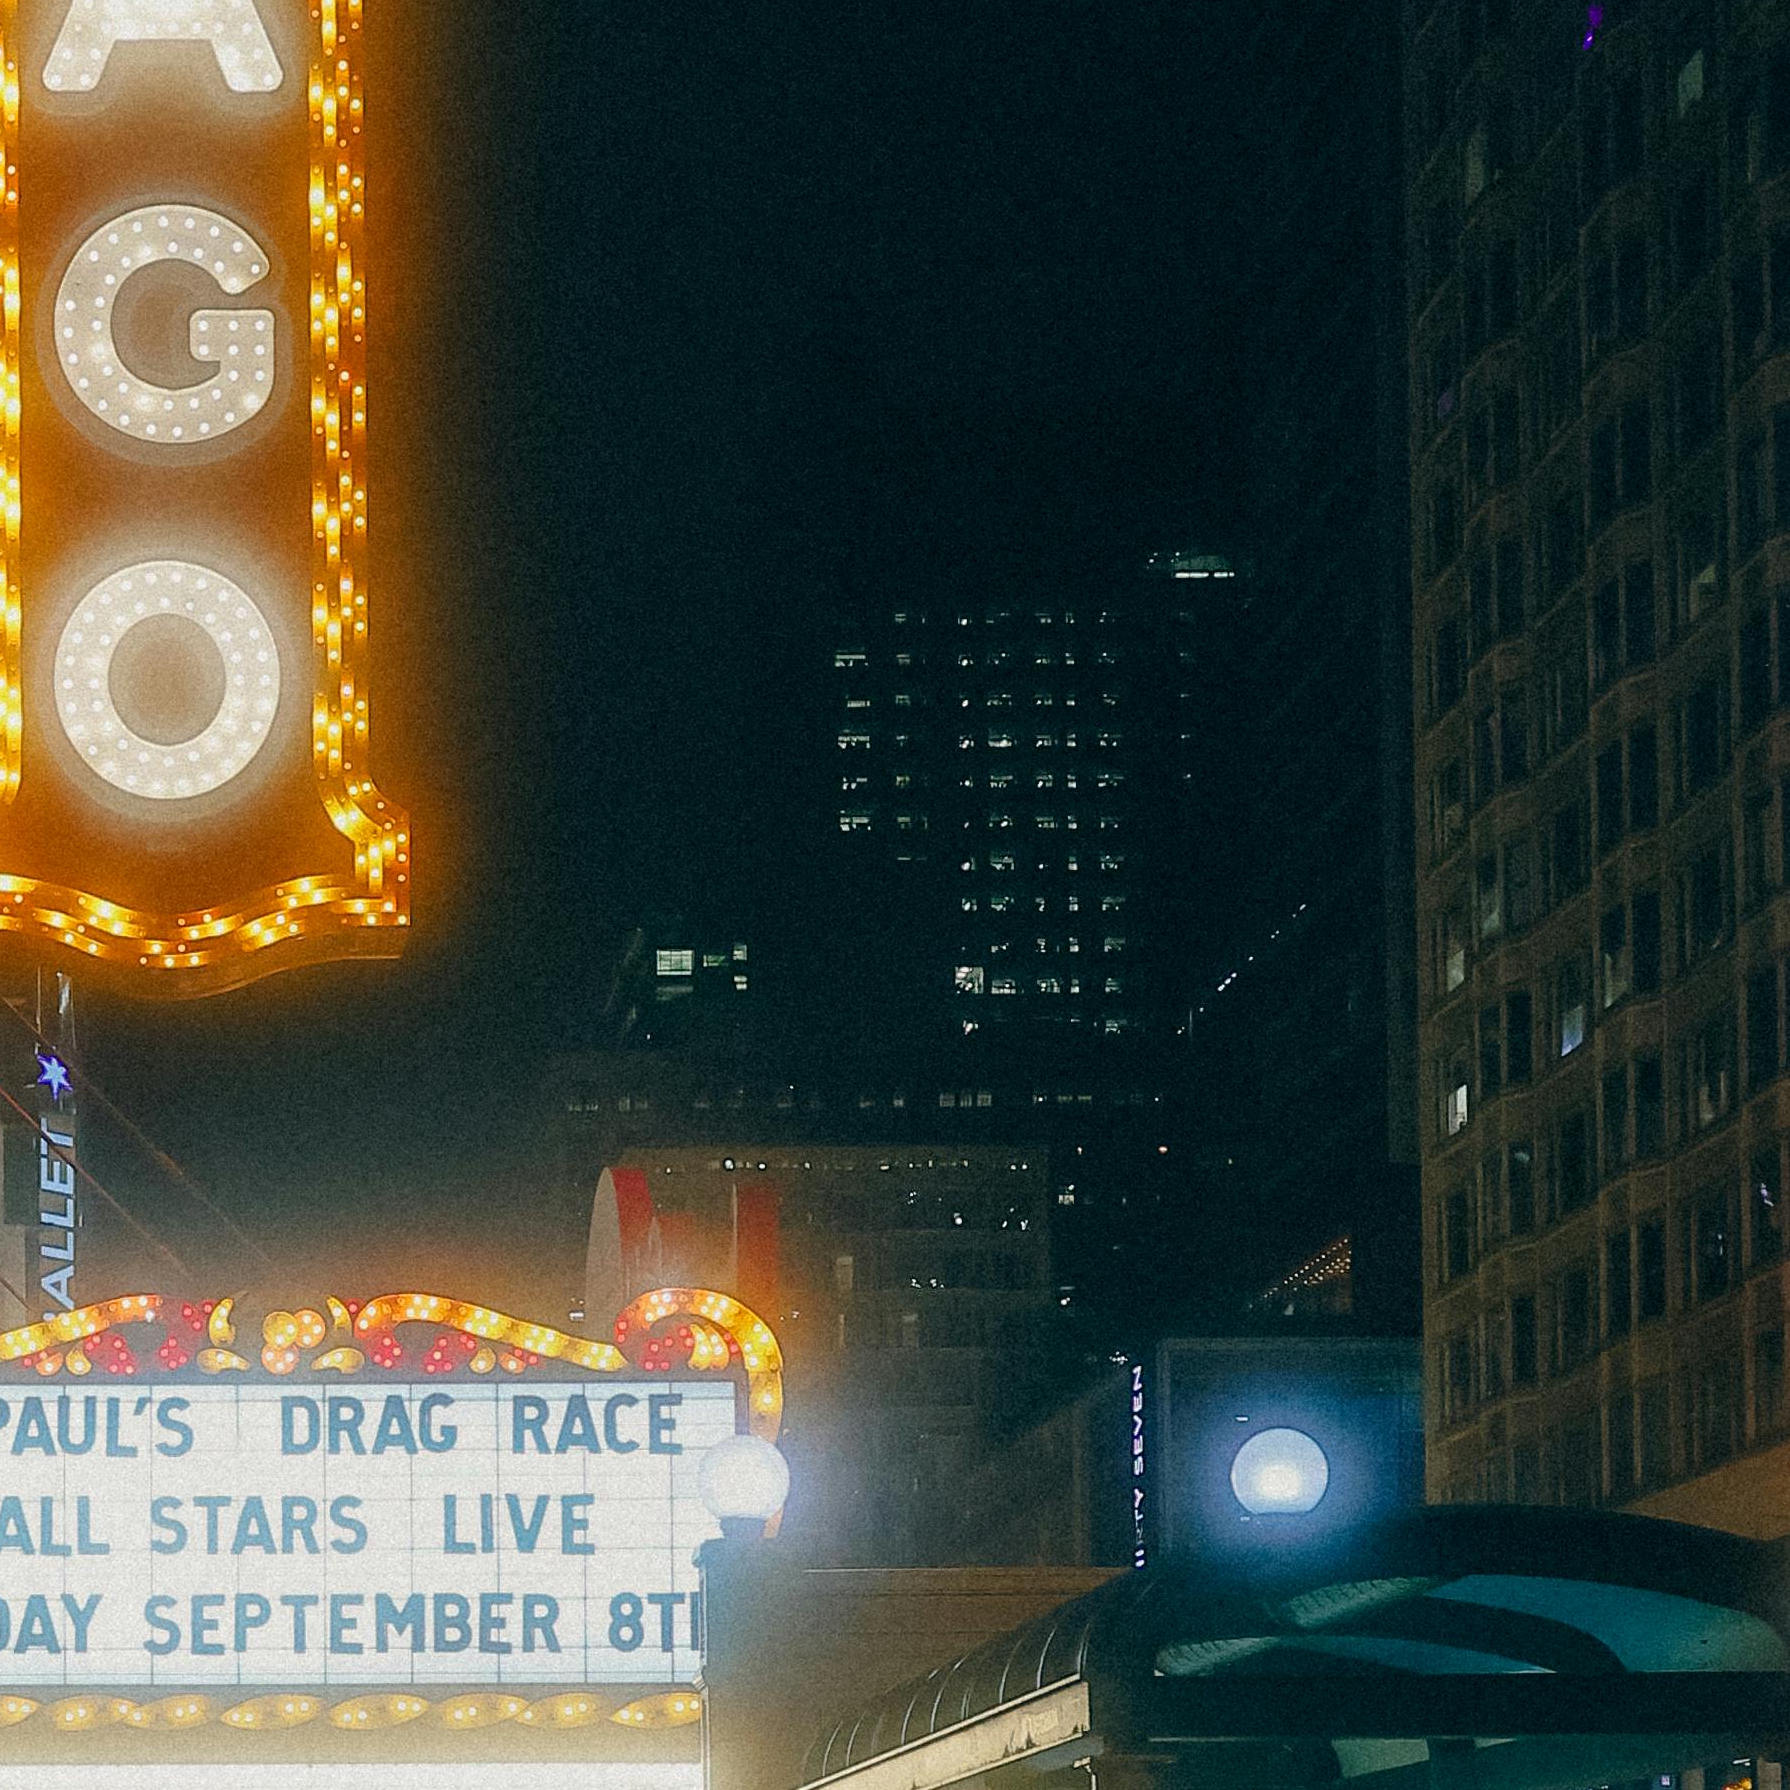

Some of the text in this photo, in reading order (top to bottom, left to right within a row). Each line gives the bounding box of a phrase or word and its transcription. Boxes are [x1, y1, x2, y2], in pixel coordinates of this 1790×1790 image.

[39, 1116, 76, 1321] ALLET
[281, 1393, 457, 1457] DRAG
[510, 1392, 684, 1456] RACE
[1132, 1365, 1143, 1476] SEVEN
[149, 1494, 369, 1556] STARS
[442, 1493, 597, 1556] LIVE
[143, 1593, 561, 1655] SEPTEMBER
